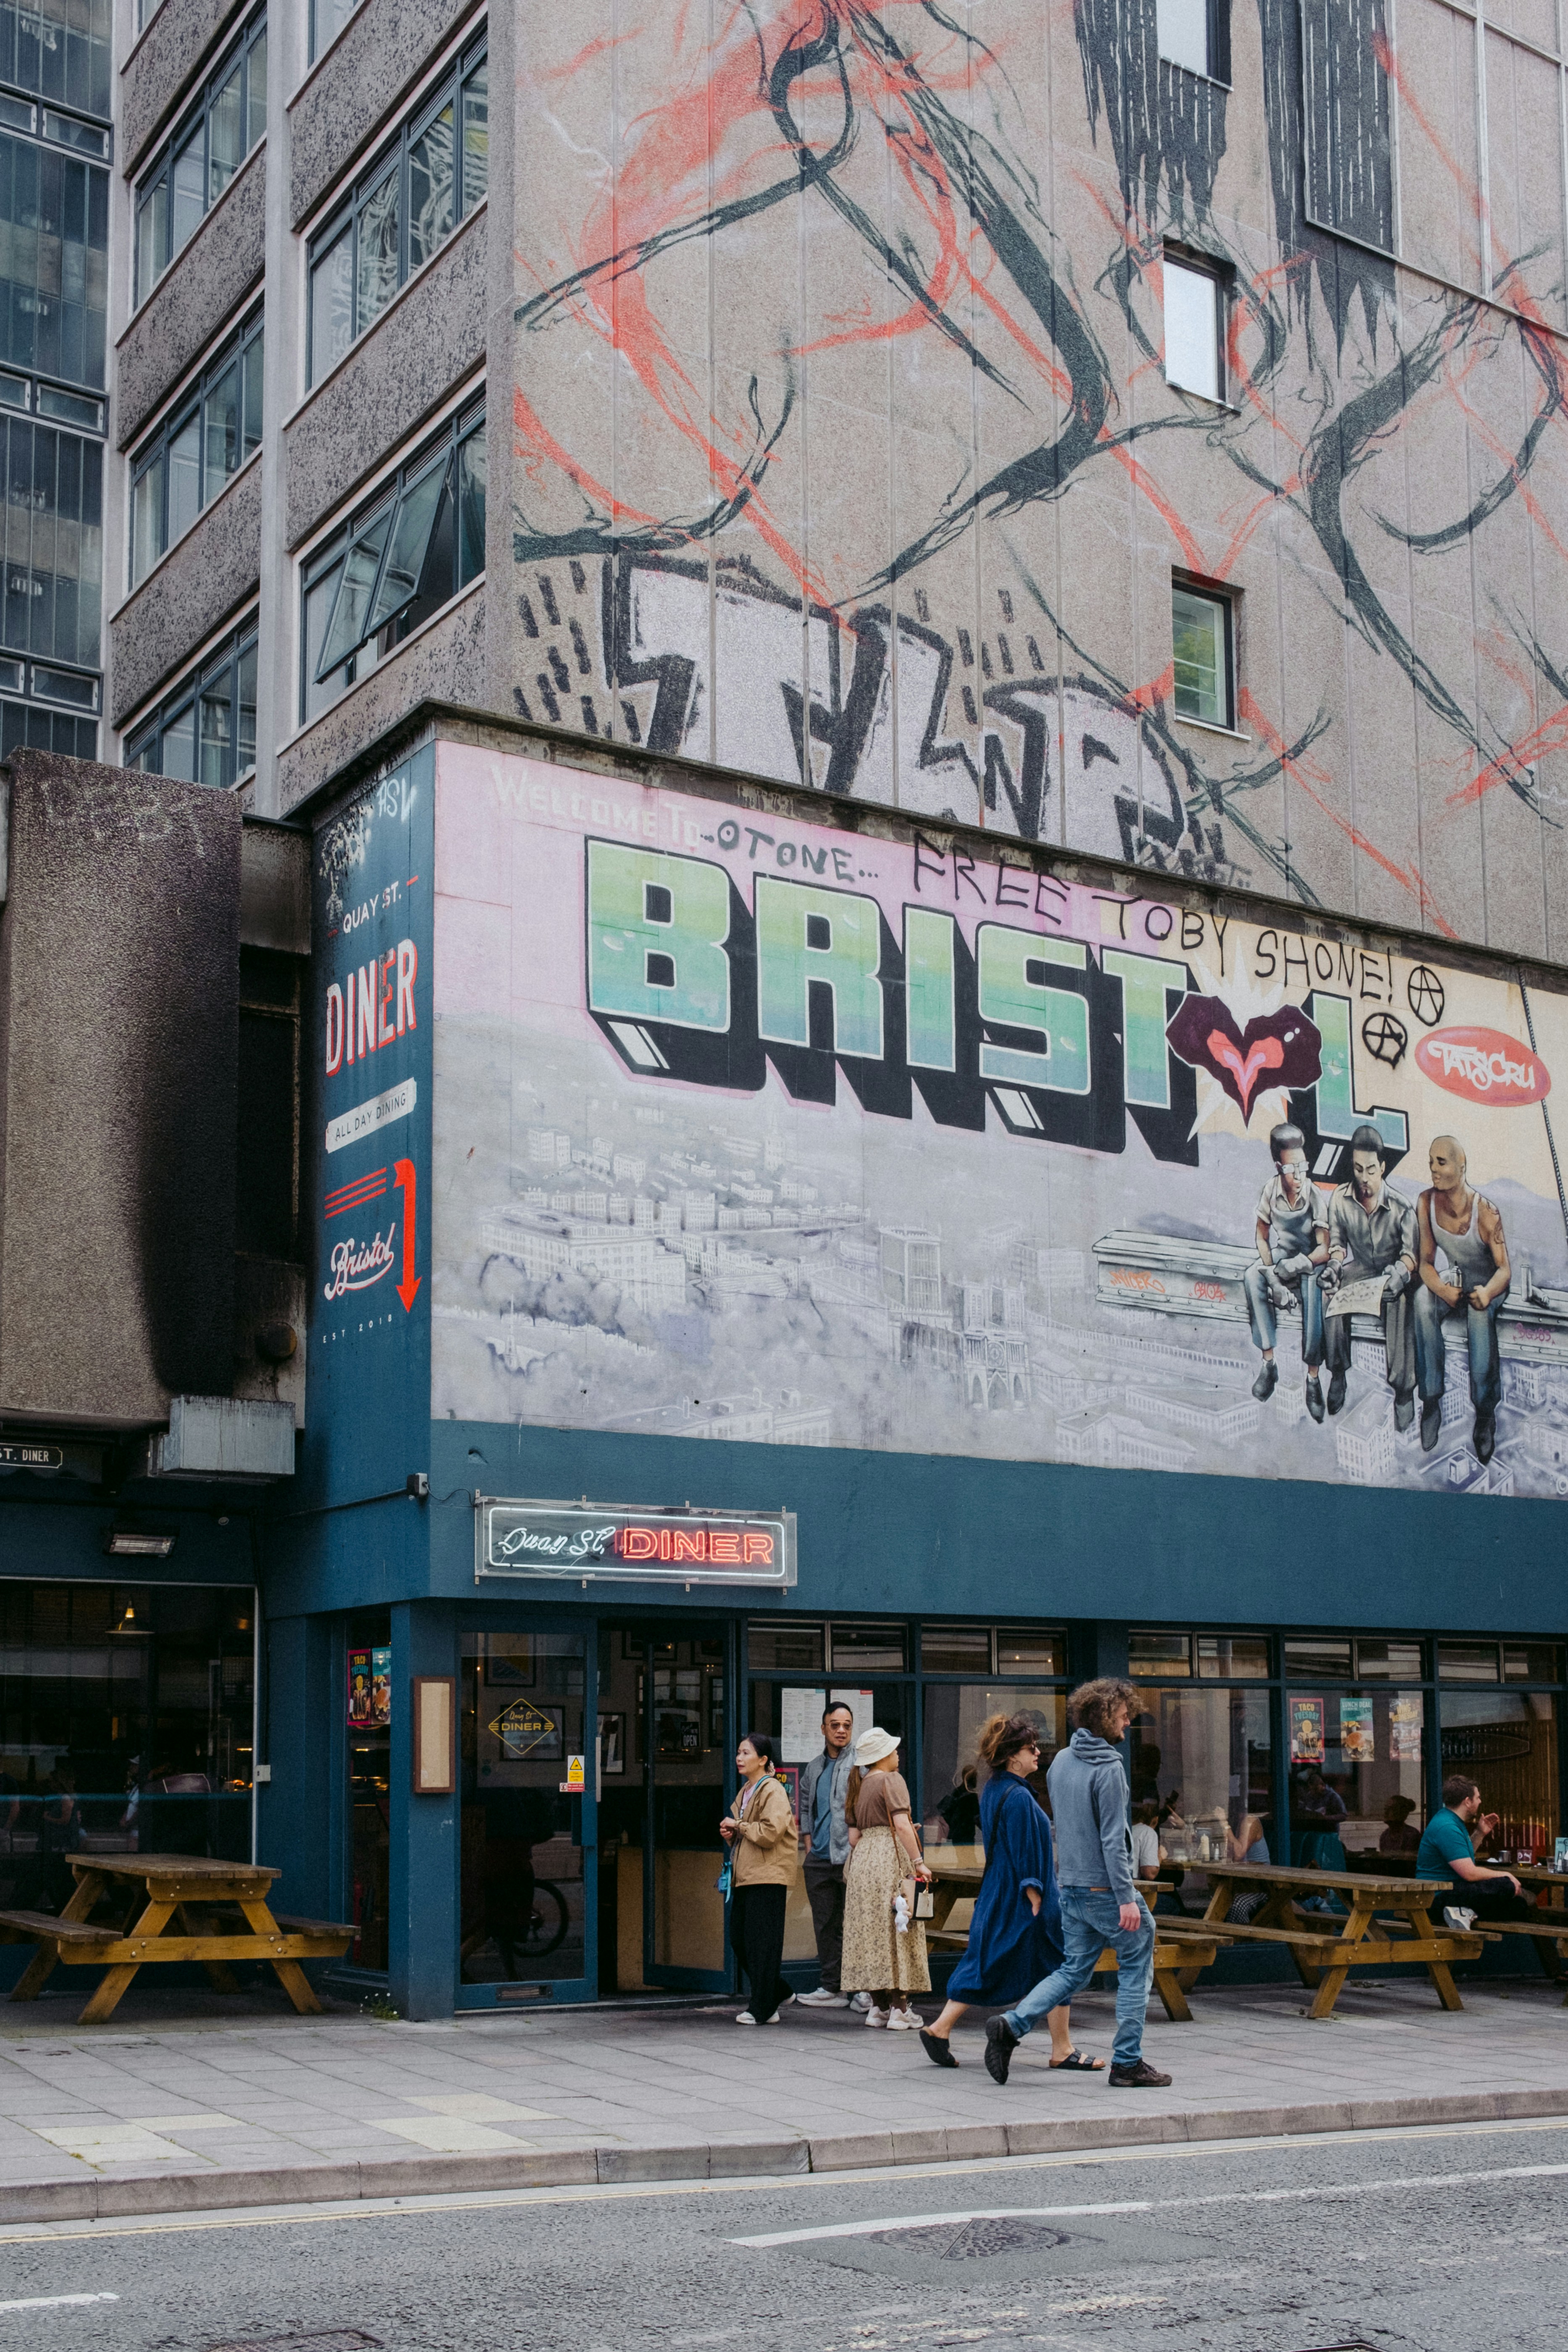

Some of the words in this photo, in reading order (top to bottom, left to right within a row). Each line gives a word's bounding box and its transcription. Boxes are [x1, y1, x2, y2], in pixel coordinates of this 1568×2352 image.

[343, 894, 378, 933] QUAY
[382, 881, 402, 909] ST.
[914, 832, 1071, 925] FREE
[1092, 895, 1229, 977] TOBY
[1255, 930, 1393, 1003] SHONE!
[326, 938, 417, 1077] DINER
[336, 1123, 351, 1141] ALL
[355, 1110, 373, 1131] DAY
[376, 1092, 406, 1120] DINING
[324, 1222, 396, 1300] Bristol
[323, 1329, 345, 1343] EST
[359, 1314, 392, 1332] 2018
[22, 1449, 49, 1462] DINER
[498, 1527, 568, 1556] Quay
[623, 1527, 774, 1564] DINER
[354, 1655, 366, 1665] TACO
[1298, 1703, 1315, 1712] TACO
[1397, 1703, 1411, 1714] WING
[509, 1711, 524, 1721] Quay
[1294, 1711, 1320, 1721] TUESDAY
[502, 1723, 542, 1731] DINER
[683, 1735, 697, 1746] OPEN
